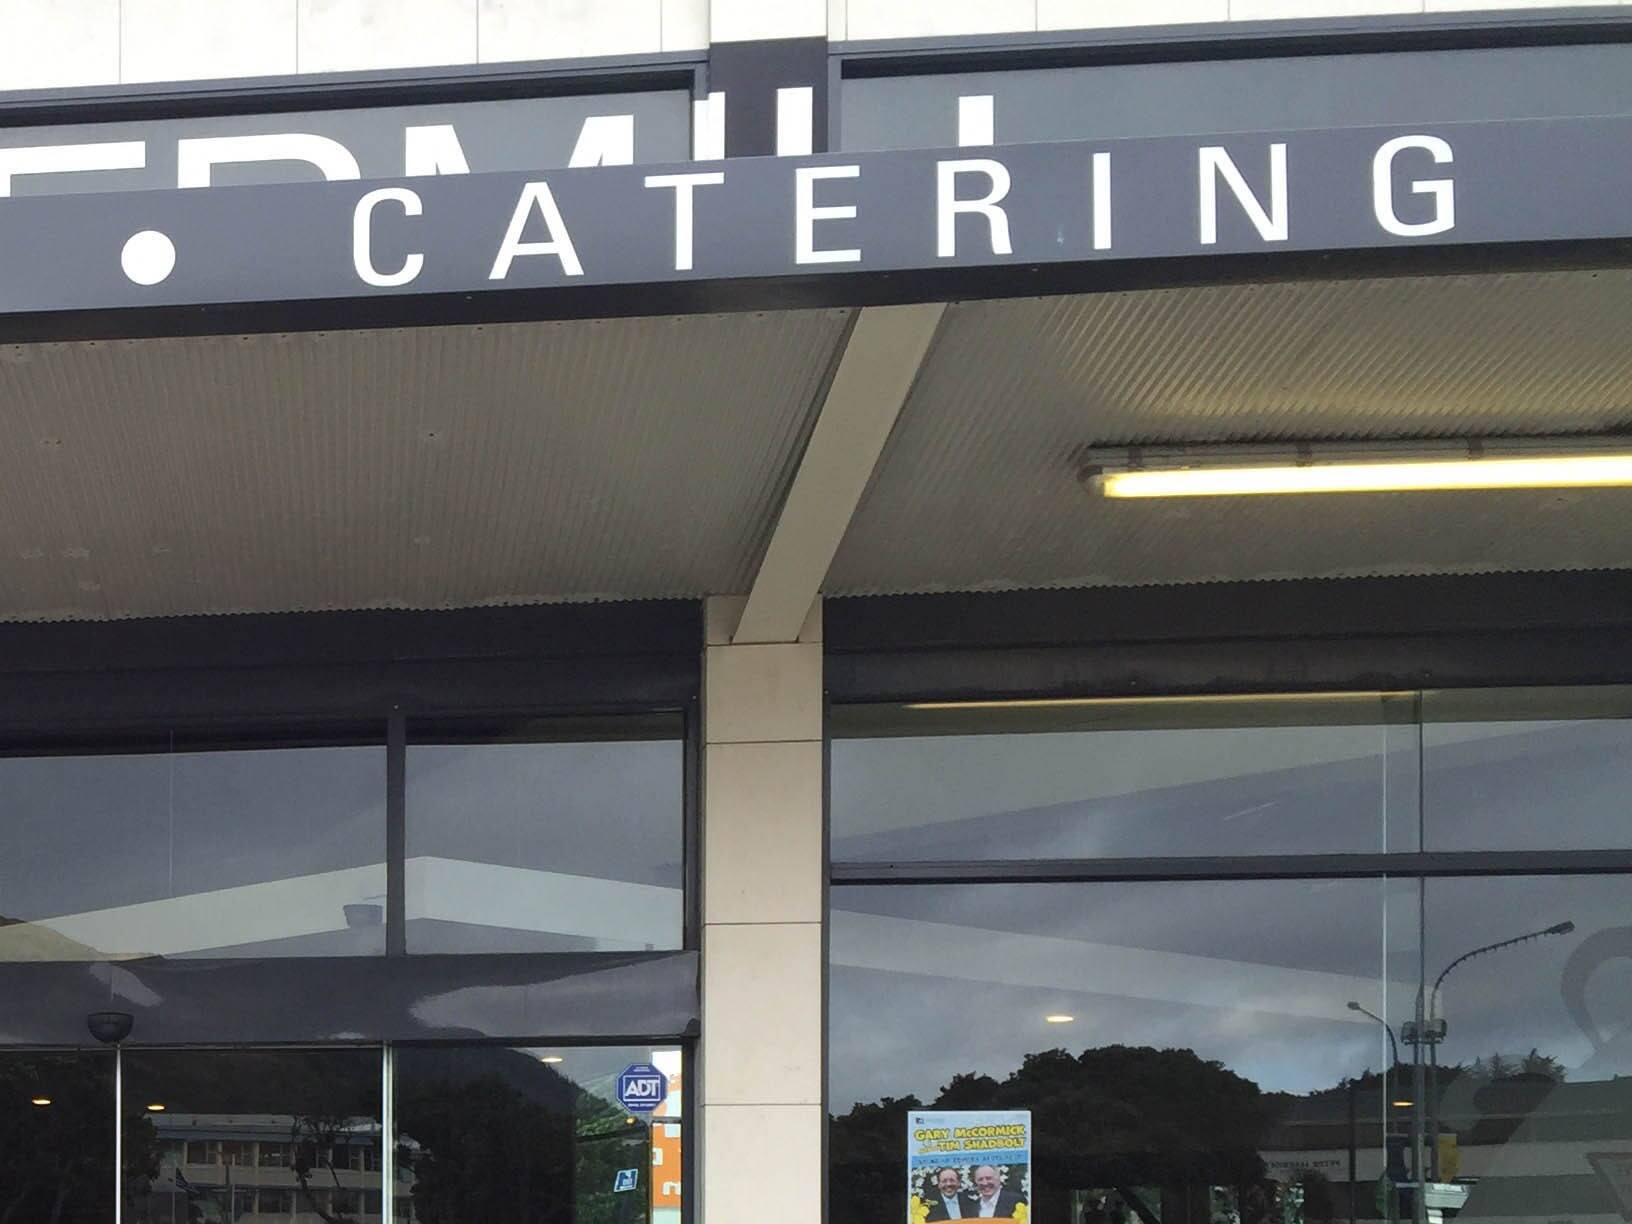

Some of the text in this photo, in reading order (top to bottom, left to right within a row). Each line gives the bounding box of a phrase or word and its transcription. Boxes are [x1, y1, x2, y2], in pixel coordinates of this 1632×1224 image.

[352, 135, 1457, 288] CATERING
[625, 1080, 659, 1097] ADT
[914, 1127, 950, 1141] GARY
[937, 1139, 960, 1151] TIM
[964, 1137, 1026, 1150] SHADBOLT
